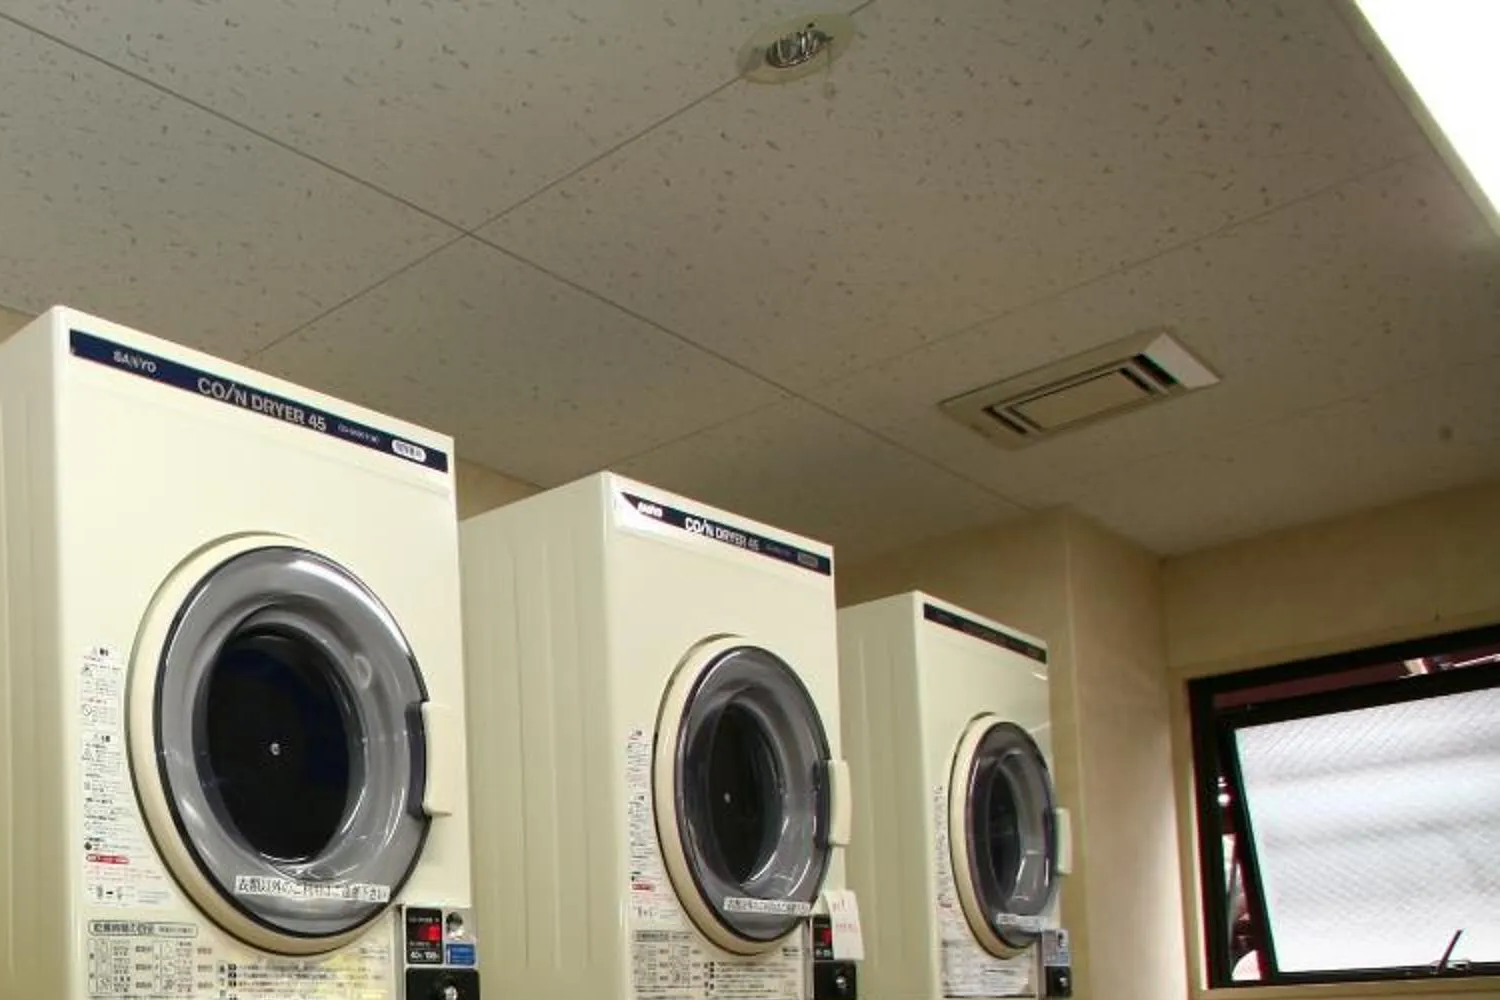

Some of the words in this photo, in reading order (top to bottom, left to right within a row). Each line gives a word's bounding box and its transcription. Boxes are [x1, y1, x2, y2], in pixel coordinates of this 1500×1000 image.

[113, 350, 157, 373] SANYO
[197, 376, 248, 407] COIN
[251, 393, 305, 424] DRYER
[307, 413, 328, 432] 45
